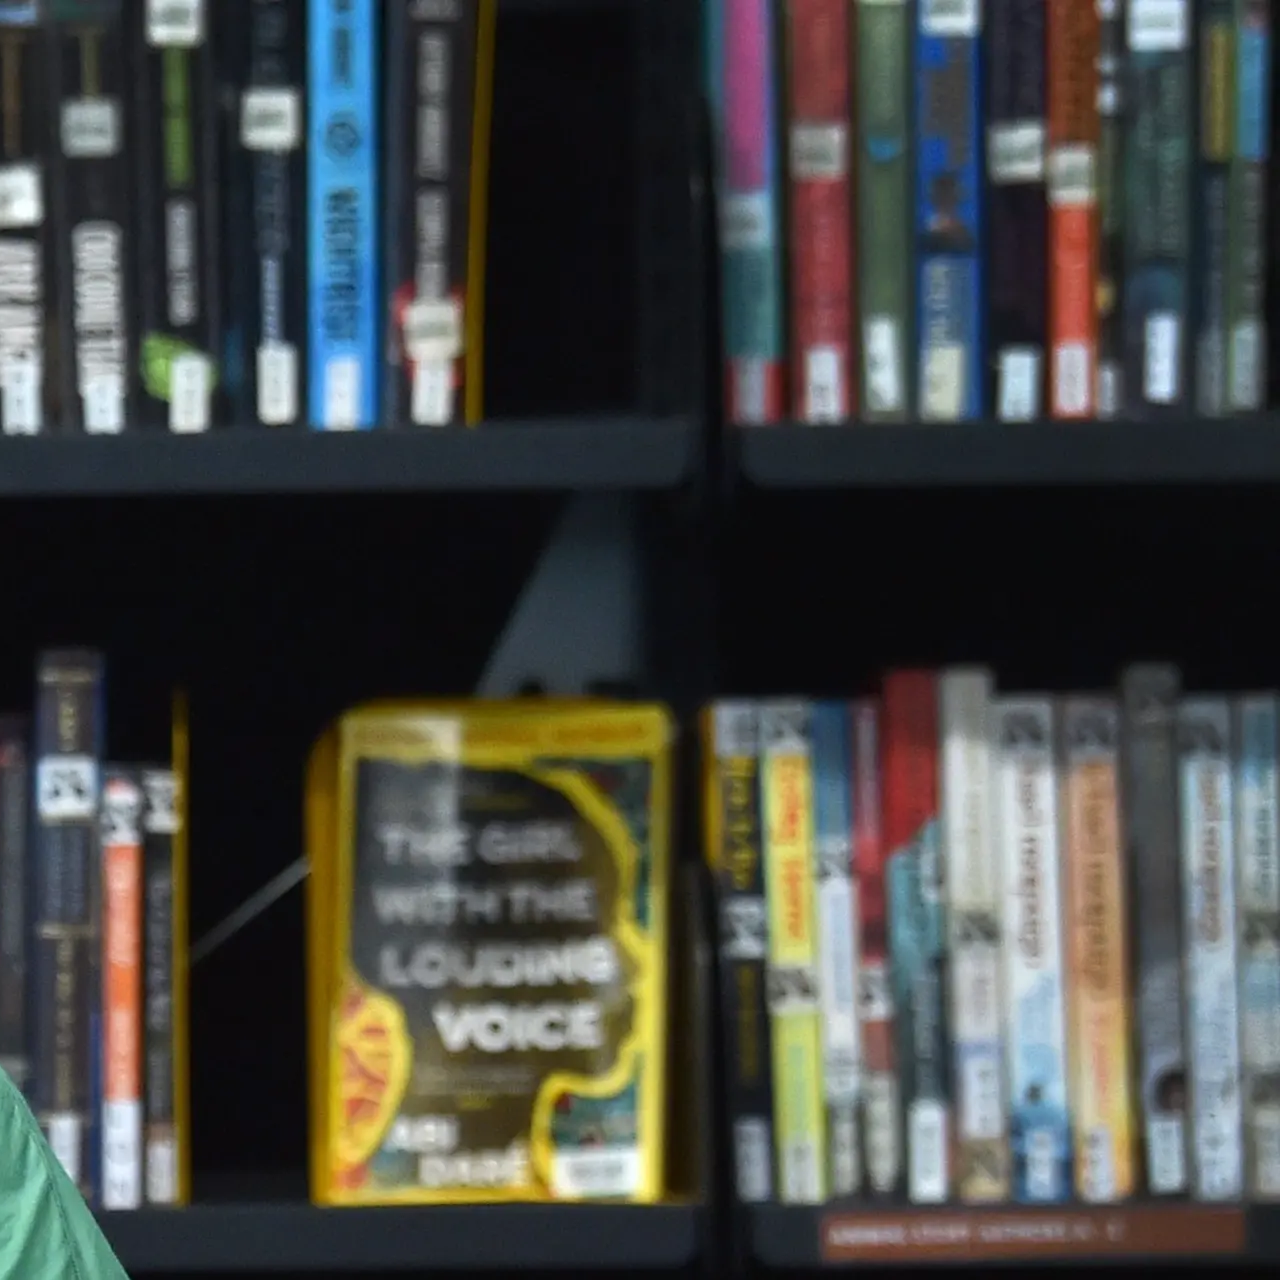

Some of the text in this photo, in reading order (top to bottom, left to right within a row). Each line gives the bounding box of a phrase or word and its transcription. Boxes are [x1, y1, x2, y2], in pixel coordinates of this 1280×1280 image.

[377, 821, 582, 864] THE GIRL
[372, 882, 596, 923] WITH THE
[377, 940, 618, 988] LOUDING
[432, 1004, 604, 1051] VOICE
